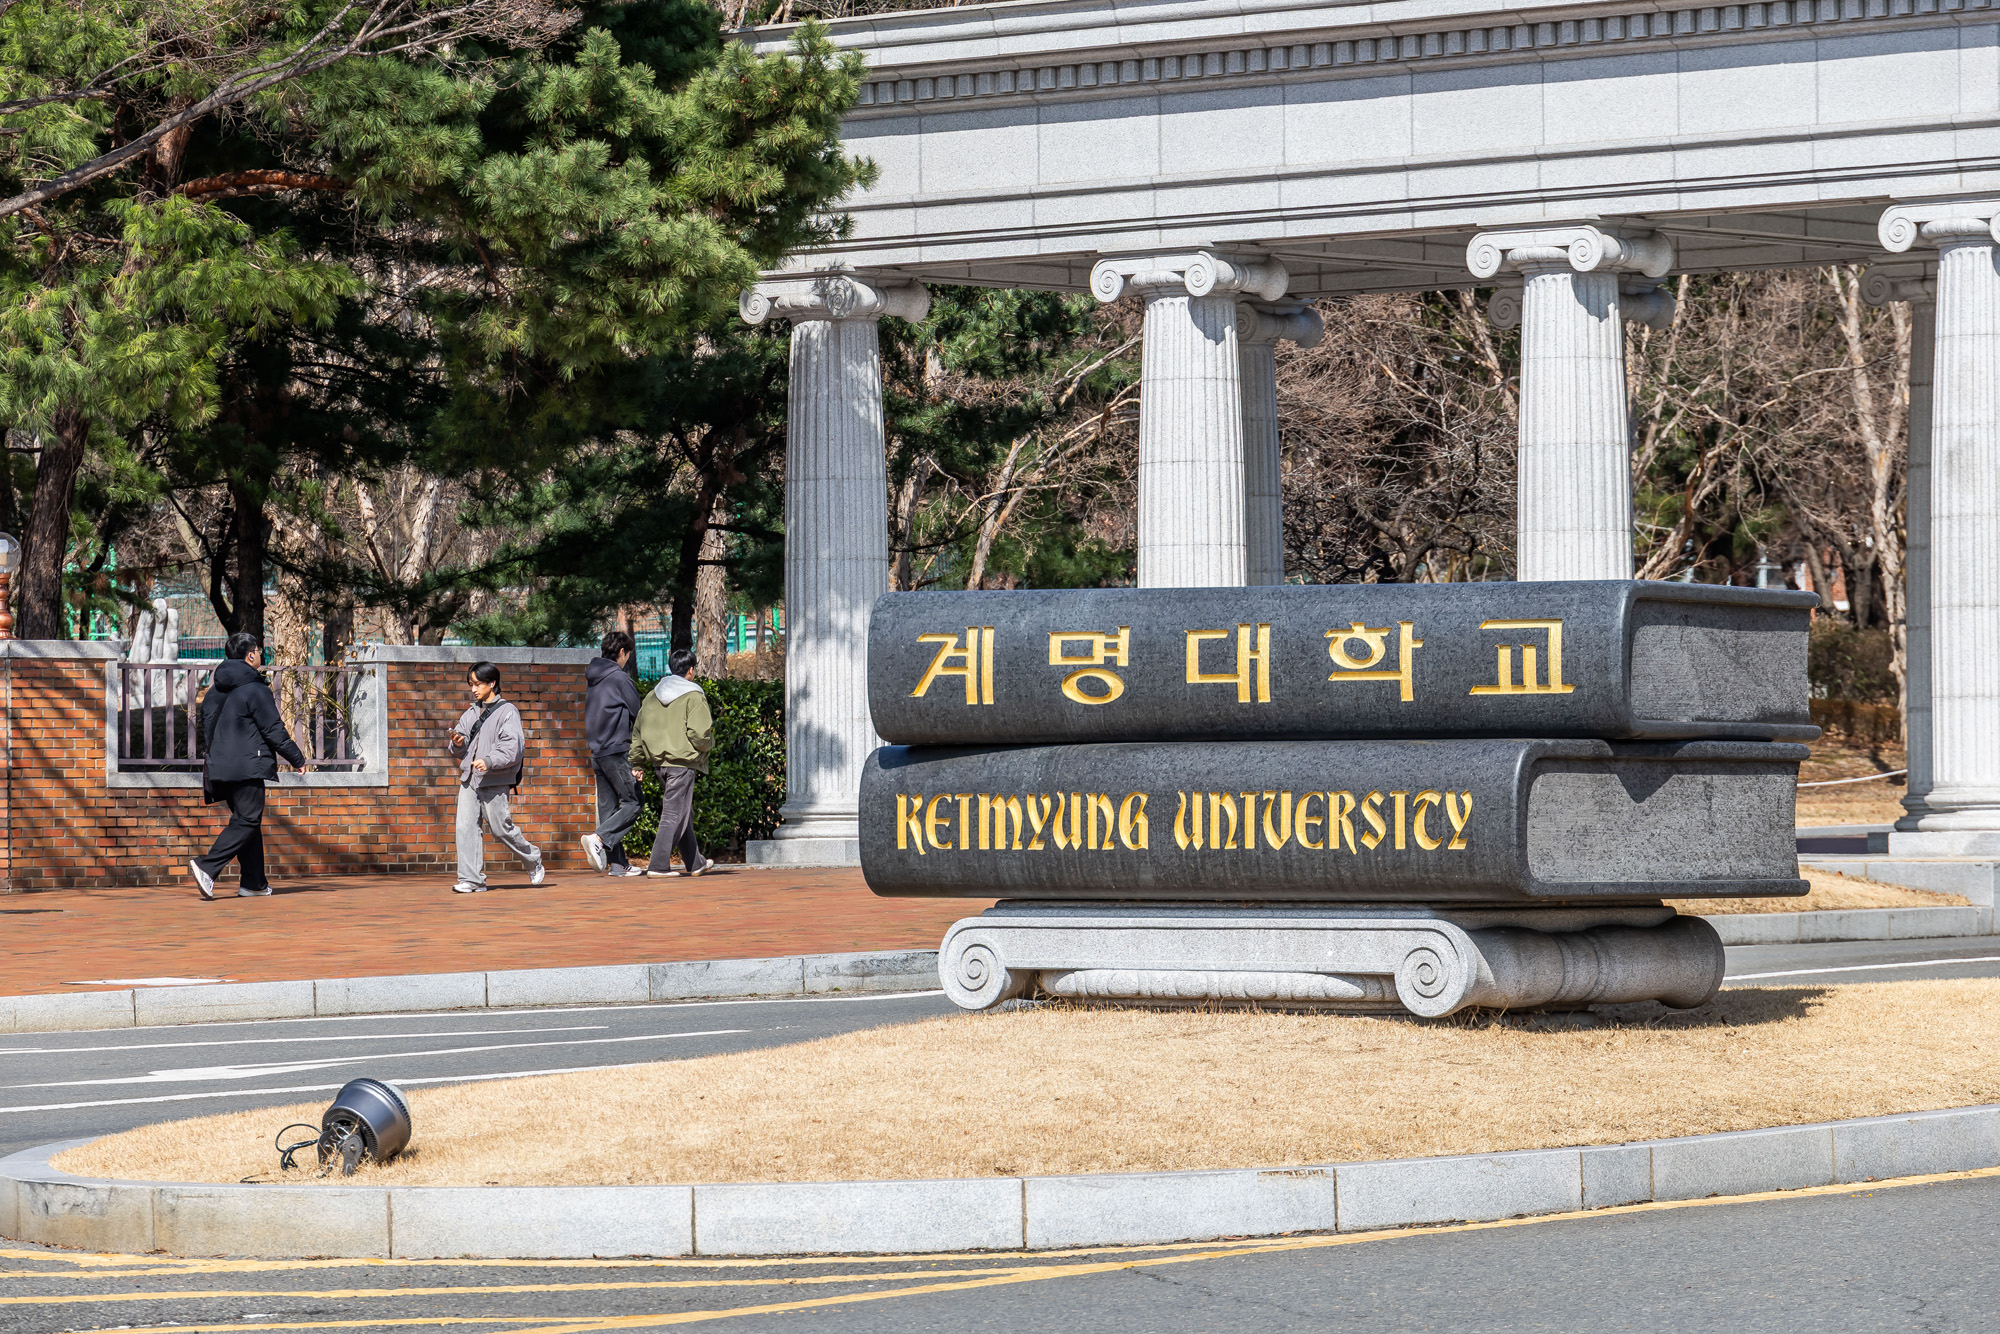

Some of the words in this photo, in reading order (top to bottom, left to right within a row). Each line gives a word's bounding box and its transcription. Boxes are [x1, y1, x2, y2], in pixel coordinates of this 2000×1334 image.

[910, 618, 1576, 706] 계명대학교
[896, 791, 1150, 856] KEIMYUNG
[1173, 789, 1474, 855] UNIVERSITY
